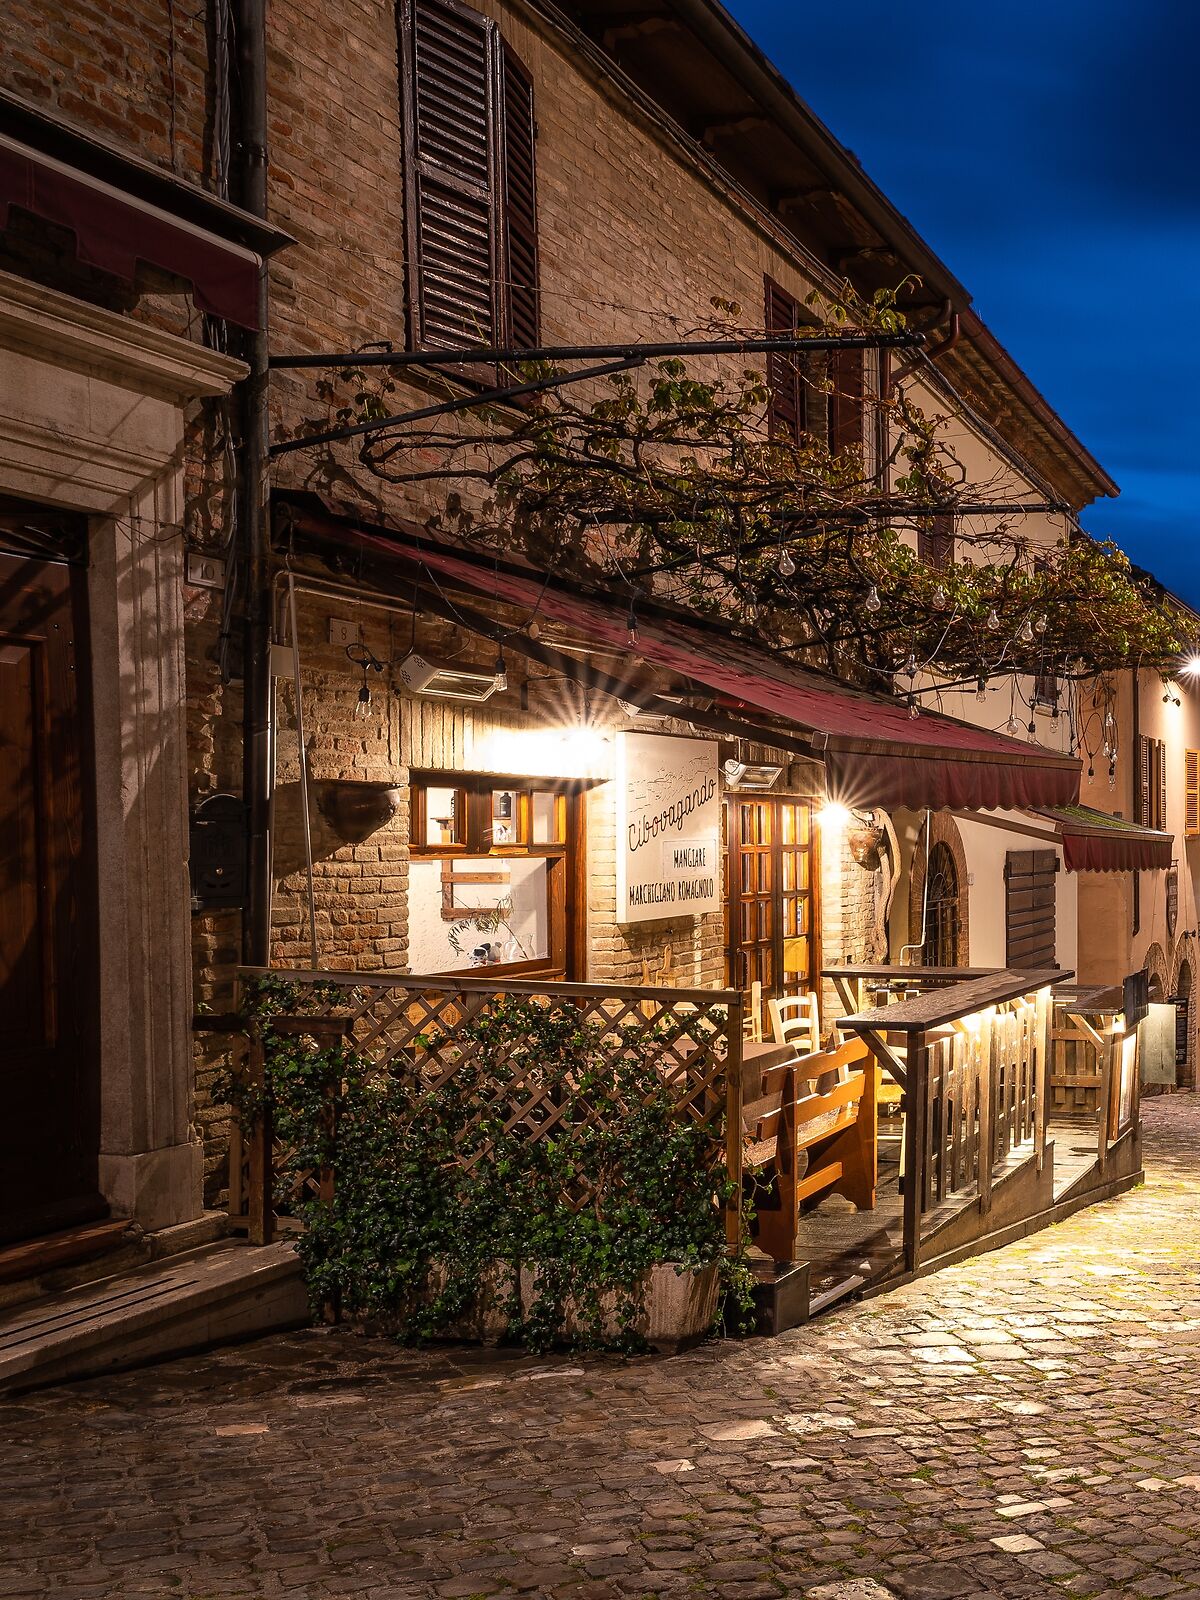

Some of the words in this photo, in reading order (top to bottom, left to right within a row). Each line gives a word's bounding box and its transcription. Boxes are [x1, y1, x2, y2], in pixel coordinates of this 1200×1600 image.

[200, 564, 215, 580] 10
[341, 627, 348, 641] 8
[628, 775, 717, 852] Cibovagando
[673, 847, 706, 869] MANGIARE
[629, 881, 676, 906] MARCHIGIANO
[678, 878, 714, 901] ROMAGNOLO
